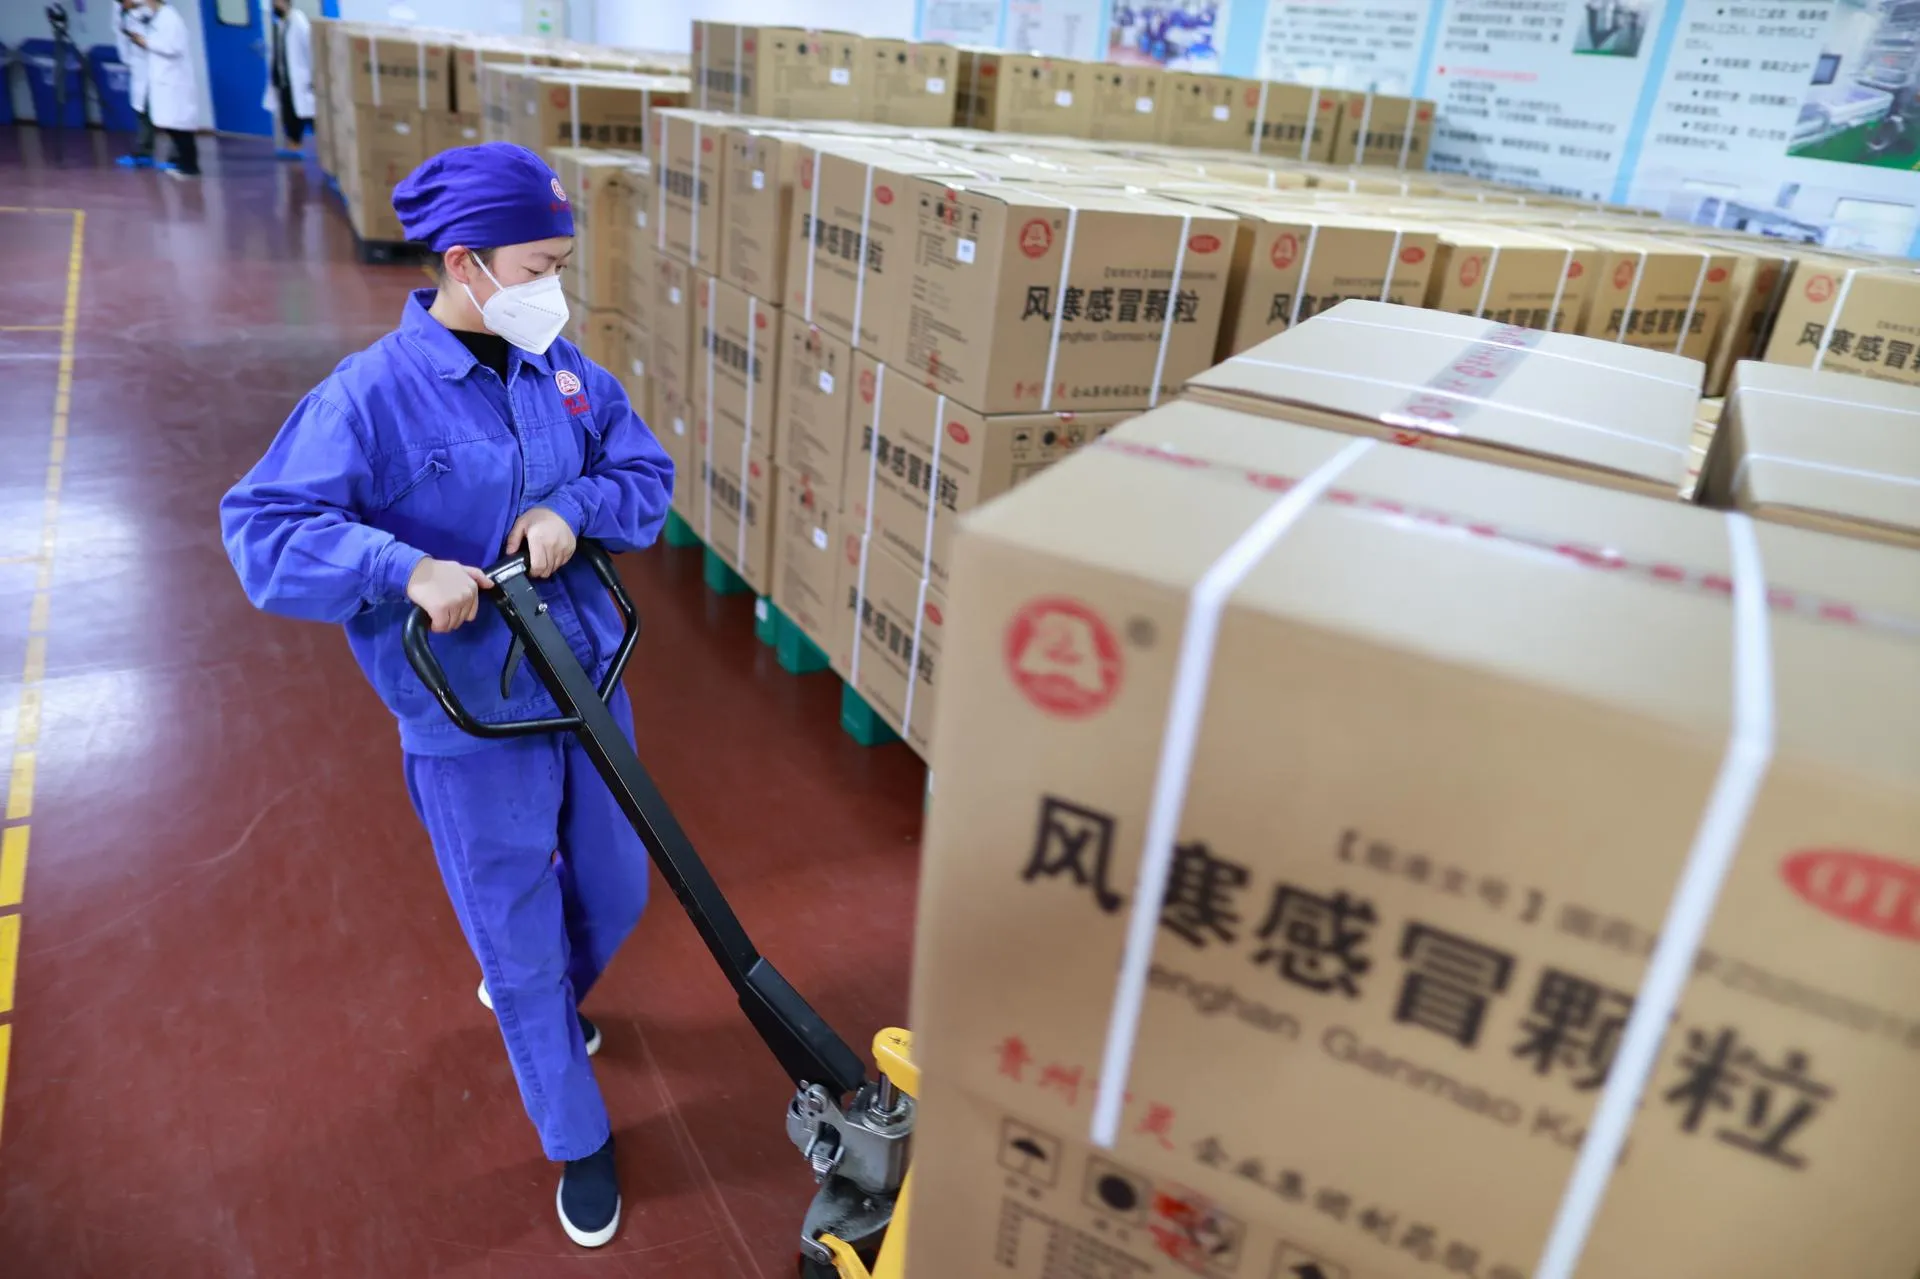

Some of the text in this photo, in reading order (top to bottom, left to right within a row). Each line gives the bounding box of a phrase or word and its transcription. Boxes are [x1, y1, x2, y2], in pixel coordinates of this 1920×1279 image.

[1021, 285, 1200, 323] 风寒感冒颗粒
[1021, 792, 1836, 1171] 风寒感冒颗粒
[1146, 961, 1301, 1041] enghan
[1320, 1024, 1523, 1129] Ganmao
